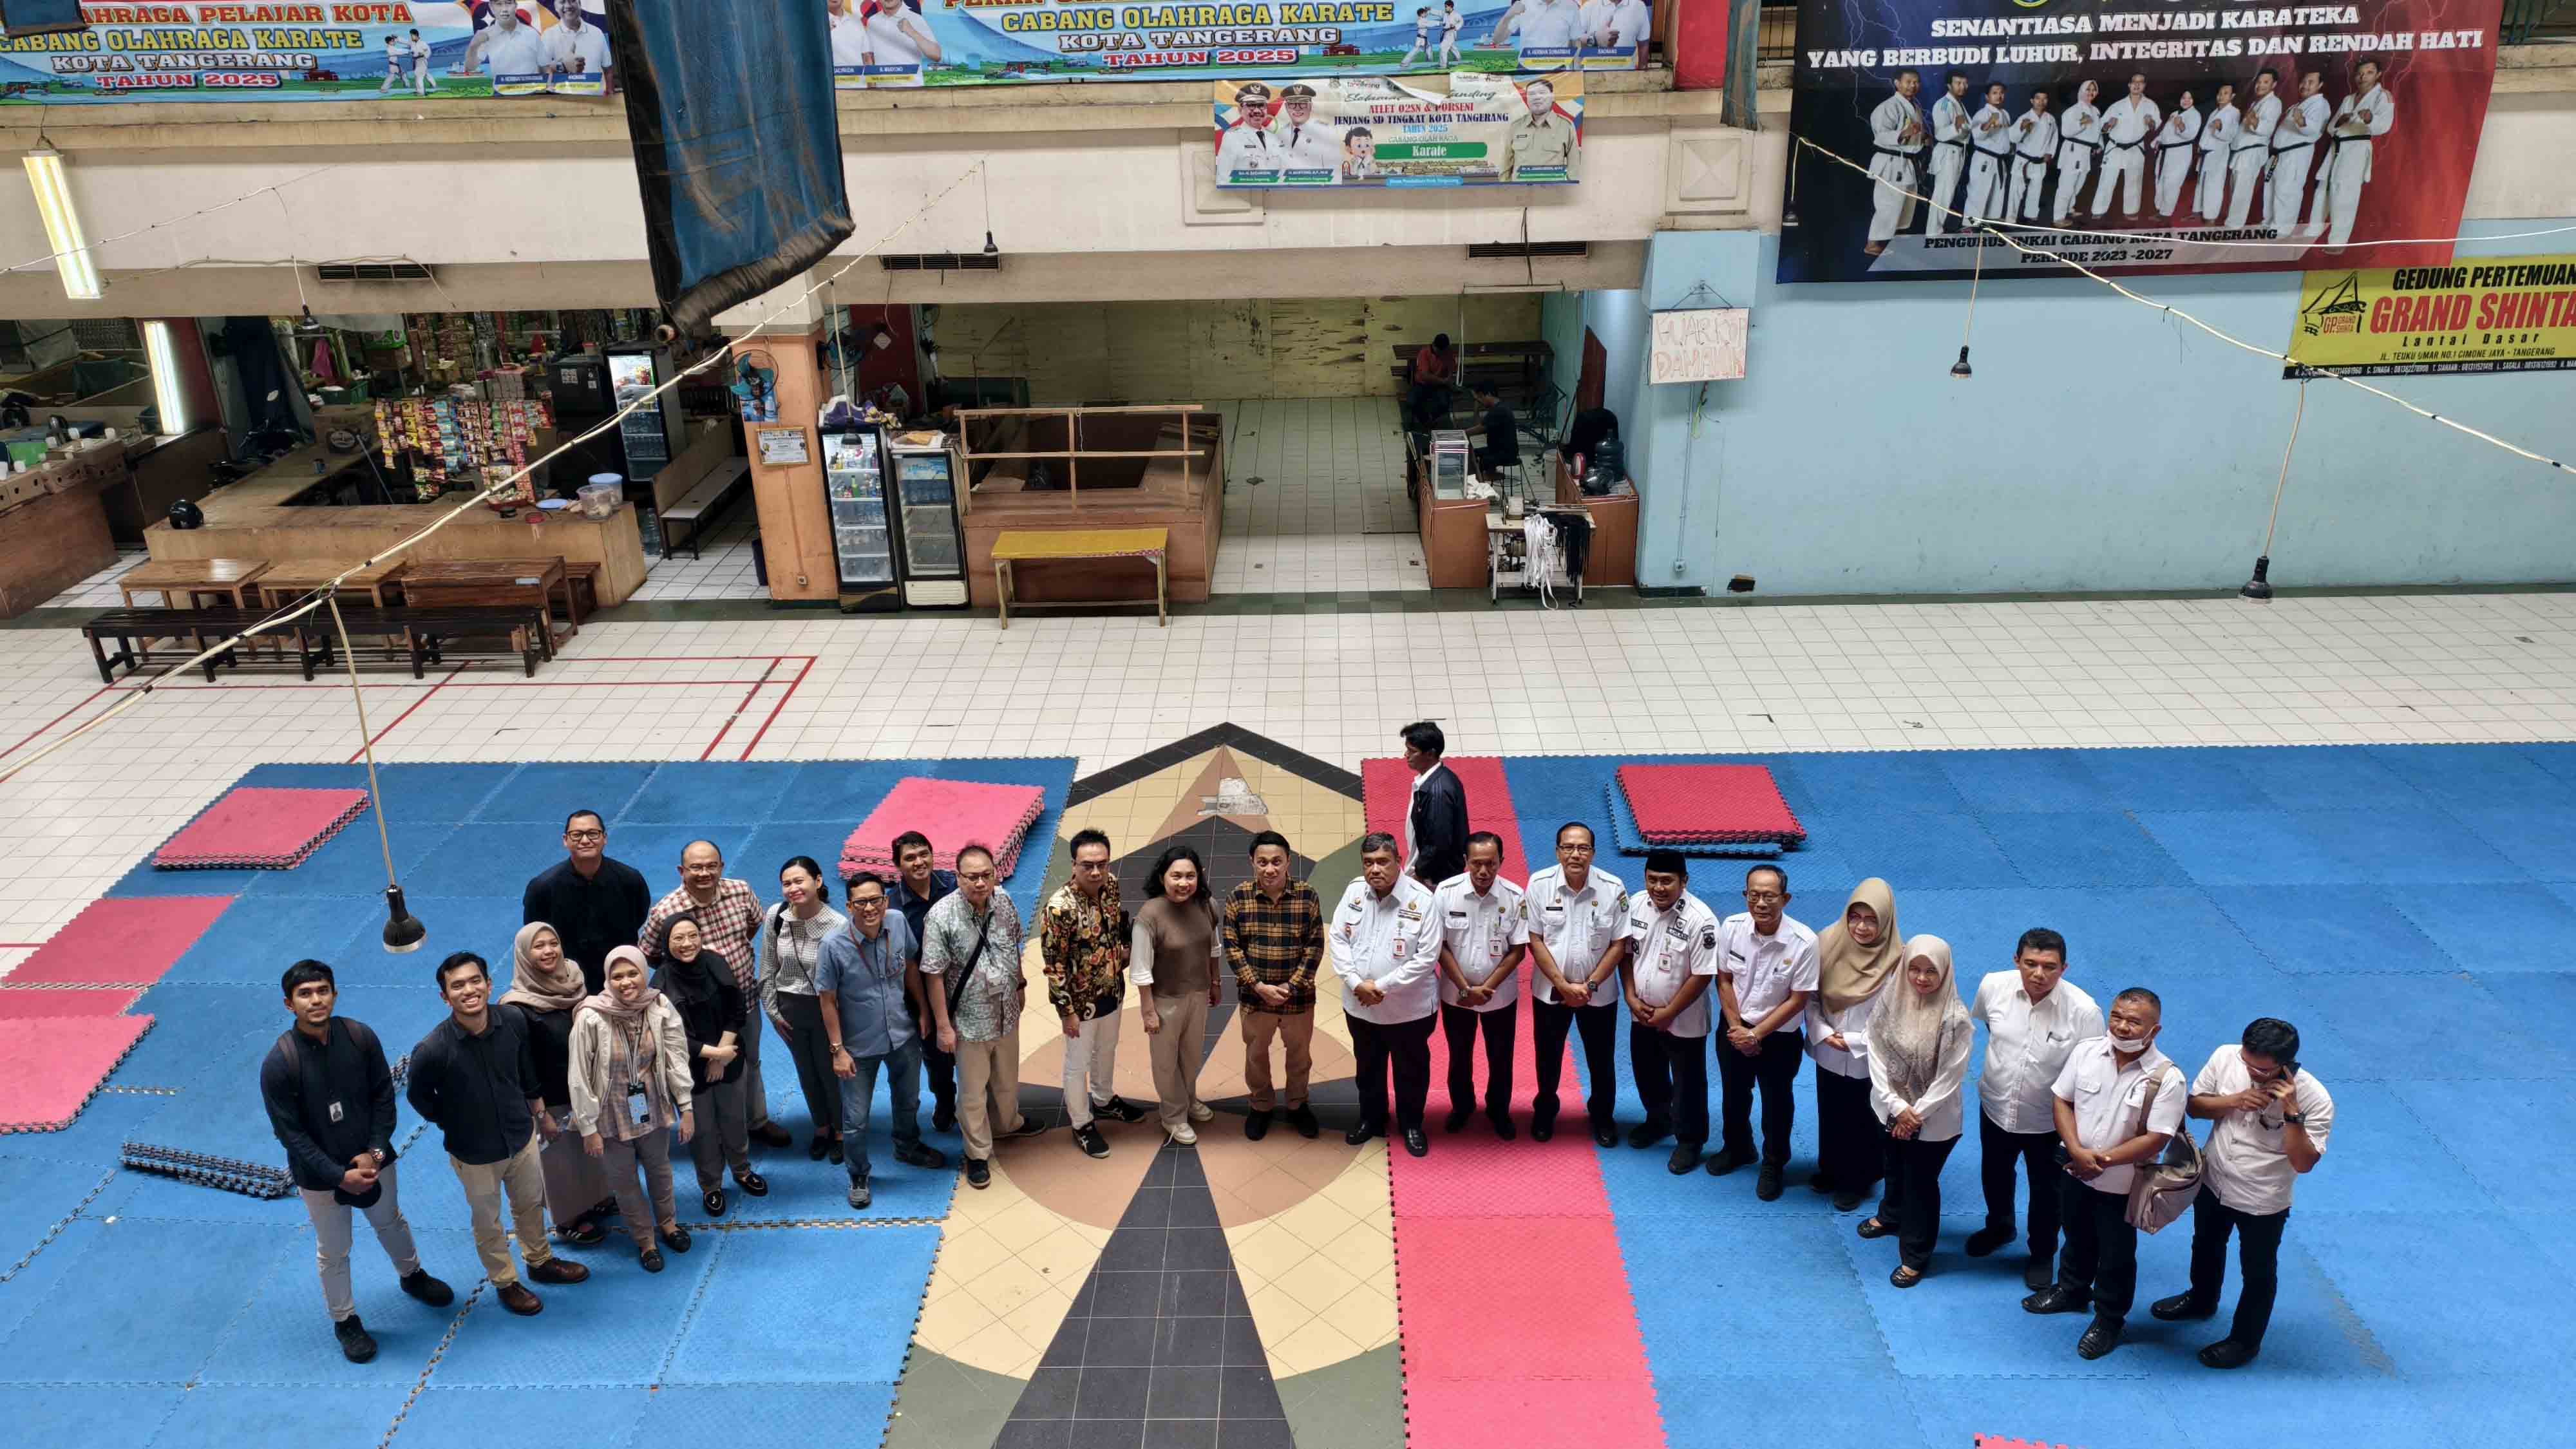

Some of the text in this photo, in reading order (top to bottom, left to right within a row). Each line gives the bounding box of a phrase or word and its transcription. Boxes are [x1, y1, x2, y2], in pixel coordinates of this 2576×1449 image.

[81, 3, 413, 24] AHRAGA PELAJAR KOTA
[1002, 3, 1394, 31] CABANG OLAHRAGA KARATE
[1931, 6, 2360, 37] SENANTIASA MENJADI KARATEKA
[106, 28, 249, 52] OLAHRAGA
[253, 28, 364, 50] KARATE
[1059, 28, 1341, 52] KOTA TANGERANG
[1807, 30, 2484, 68] YANG BERBUDI LUHUR, INTEGRITAS DAN RENDAH HATI
[52, 53, 318, 73] KOTA TANGERANG
[1103, 49, 1299, 66] TAHUN 2025
[95, 71, 282, 89] TAHUN 2025
[1424, 103, 1430, 112] &
[1334, 116, 1370, 125] JENJANG
[1388, 115, 1425, 124] TINGKAT
[1429, 114, 1452, 123] KOTA
[1456, 113, 1508, 122] TANGERANG
[1428, 124, 1448, 133] 2025
[1412, 145, 1447, 156] Karate
[1924, 236, 2007, 249] PENGURUS
[2060, 233, 2126, 246] CABANG
[2178, 229, 2278, 242] TANGERANG
[2092, 250, 2128, 261] 2023
[2392, 267, 2468, 290] GEDUNG
[2370, 294, 2472, 334] GRAND
[2402, 334, 2539, 346] Lantai Dasar
[2393, 352, 2414, 361] TEUKU
[2488, 349, 2505, 357] JAYA
[2514, 347, 2555, 356] TANGERANG
